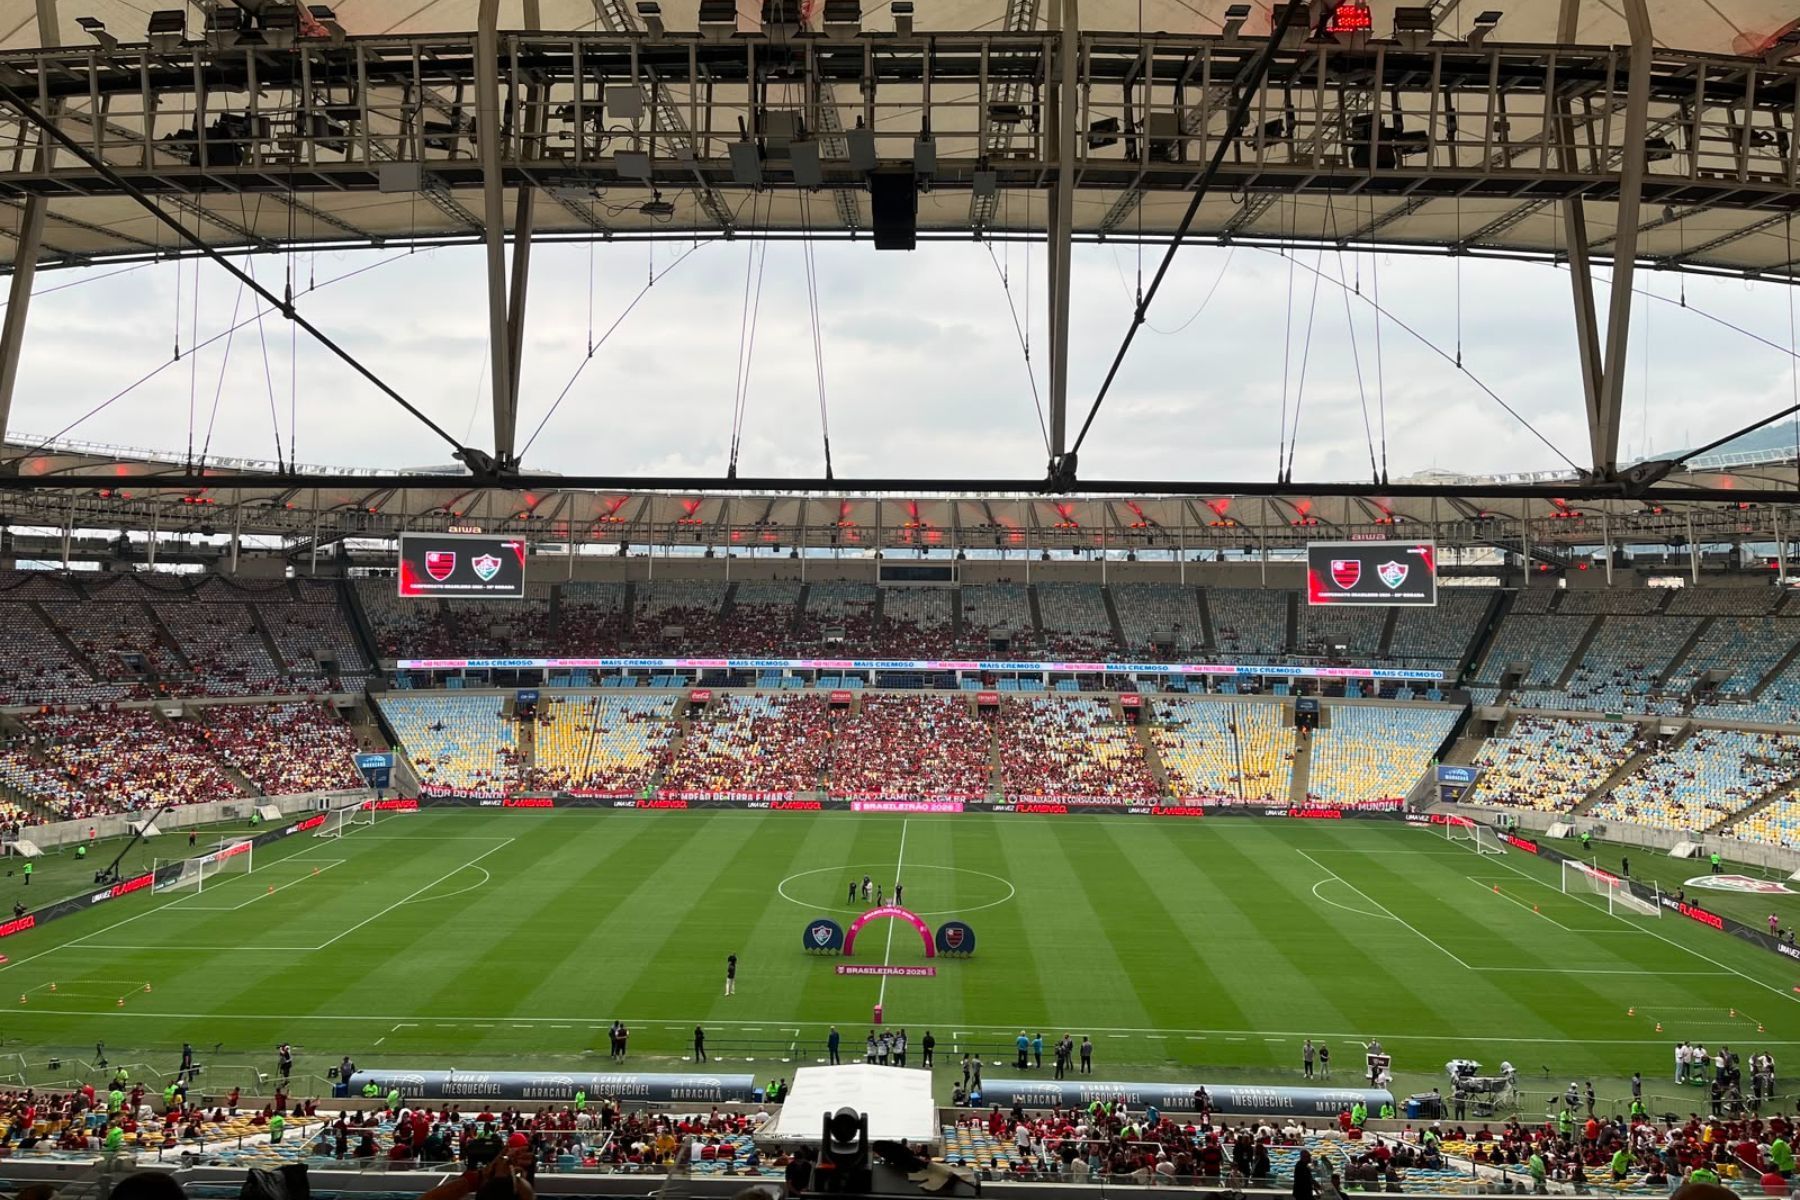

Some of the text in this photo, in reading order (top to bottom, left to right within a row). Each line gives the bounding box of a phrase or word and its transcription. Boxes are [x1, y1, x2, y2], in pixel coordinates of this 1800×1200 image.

[448, 526, 482, 534] aiwa
[1351, 533, 1386, 541] aiwa
[846, 966, 926, 976] BRASILEIRÃO 2026
[522, 1086, 573, 1098] MARACANÃ
[671, 1087, 721, 1099] MARACANÃ
